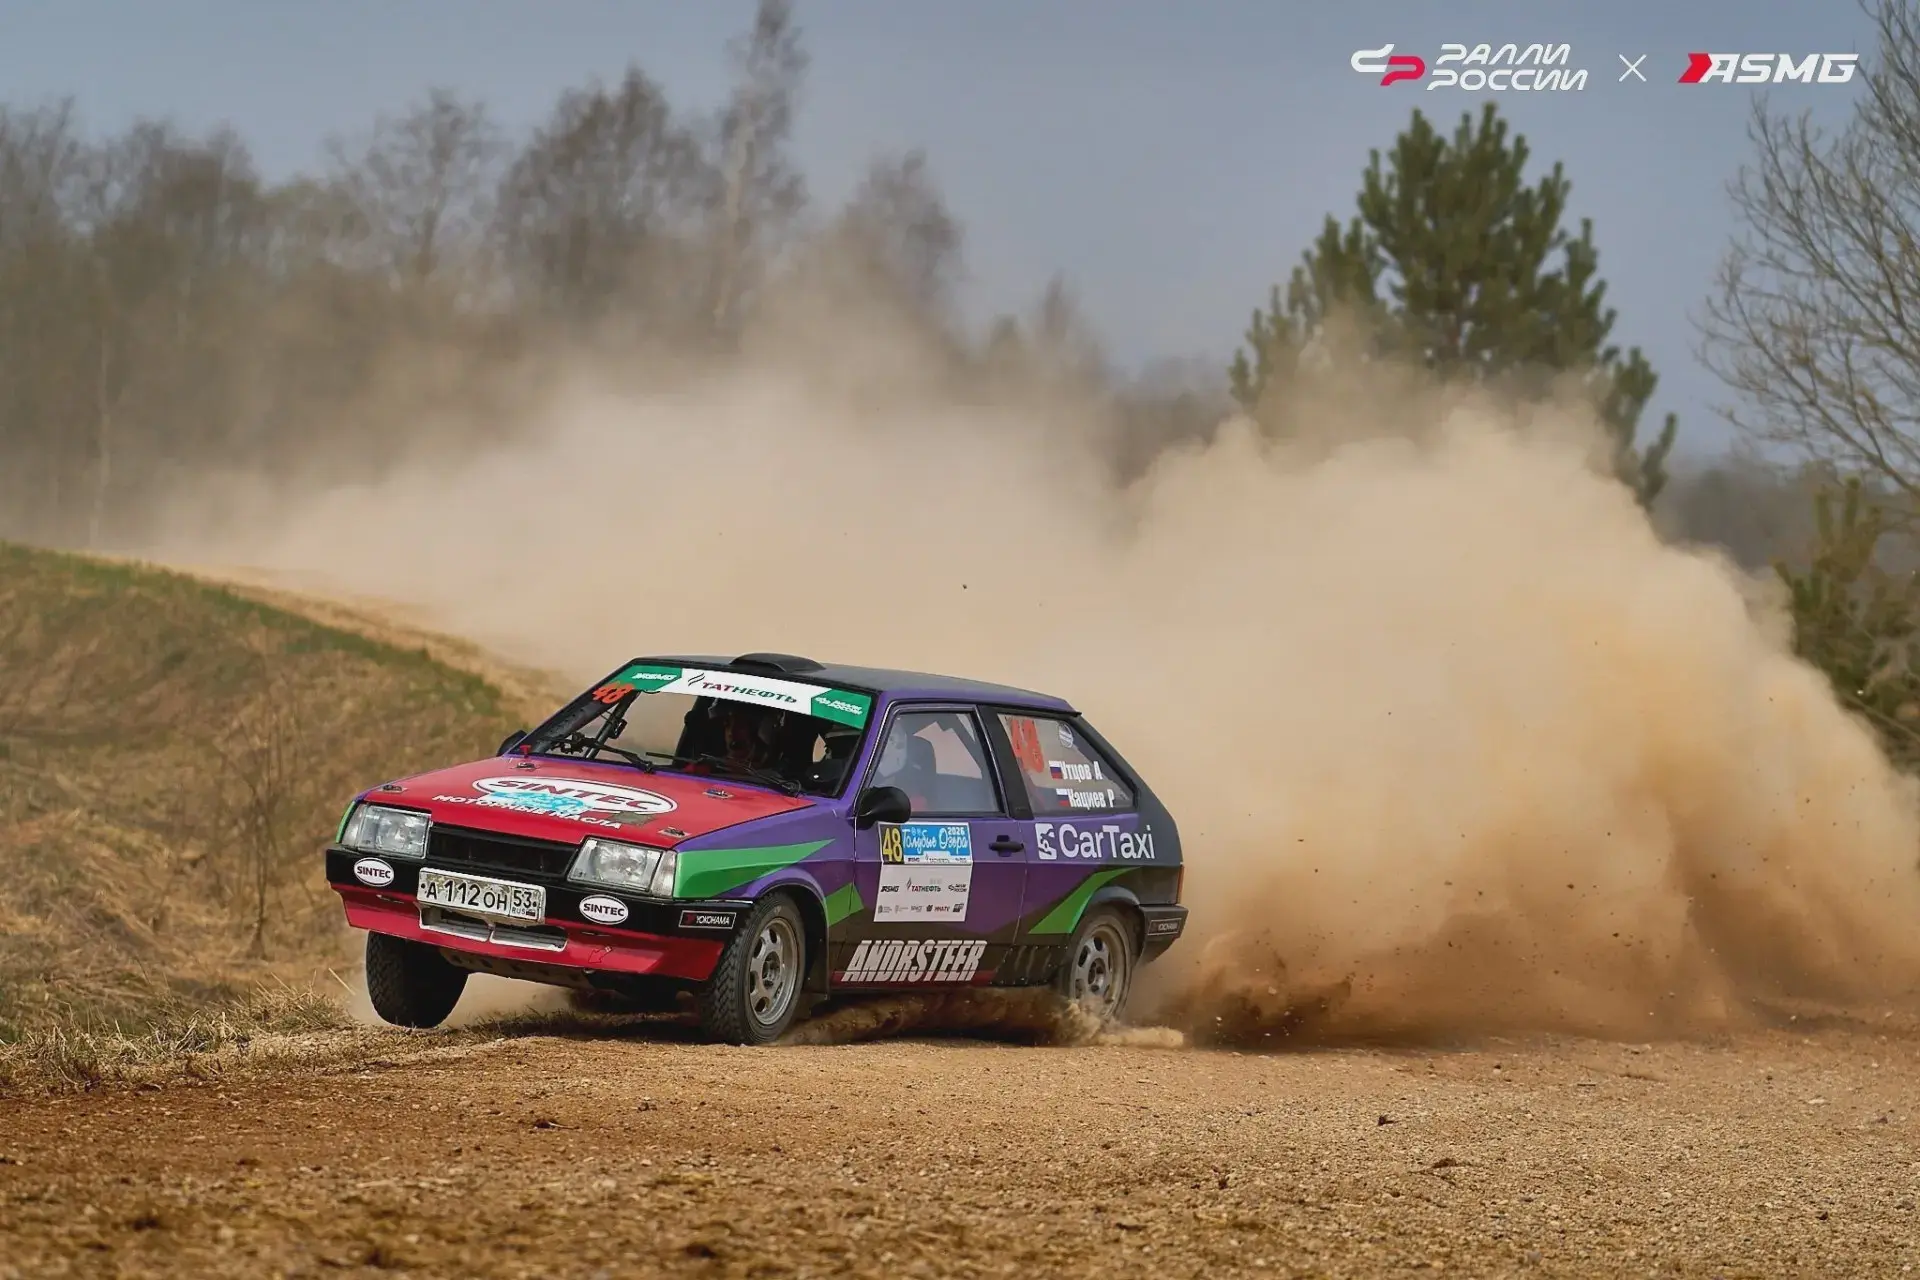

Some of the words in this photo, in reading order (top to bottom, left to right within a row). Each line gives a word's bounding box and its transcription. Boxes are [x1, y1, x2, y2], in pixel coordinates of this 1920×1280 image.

[592, 681, 634, 704] 48
[702, 682, 798, 704] ТАТНЕФТЬ
[489, 780, 663, 811] SINTEC
[882, 827, 903, 862] 48
[1058, 823, 1156, 859] CarTaxi
[356, 865, 391, 880] SINTEC
[513, 889, 532, 909] 53
[911, 885, 942, 893] ТАТНЕФТЬ
[583, 902, 625, 917] SINTEC
[696, 915, 730, 925] YOKOHAMA
[840, 939, 988, 983] ANDRSTEER
